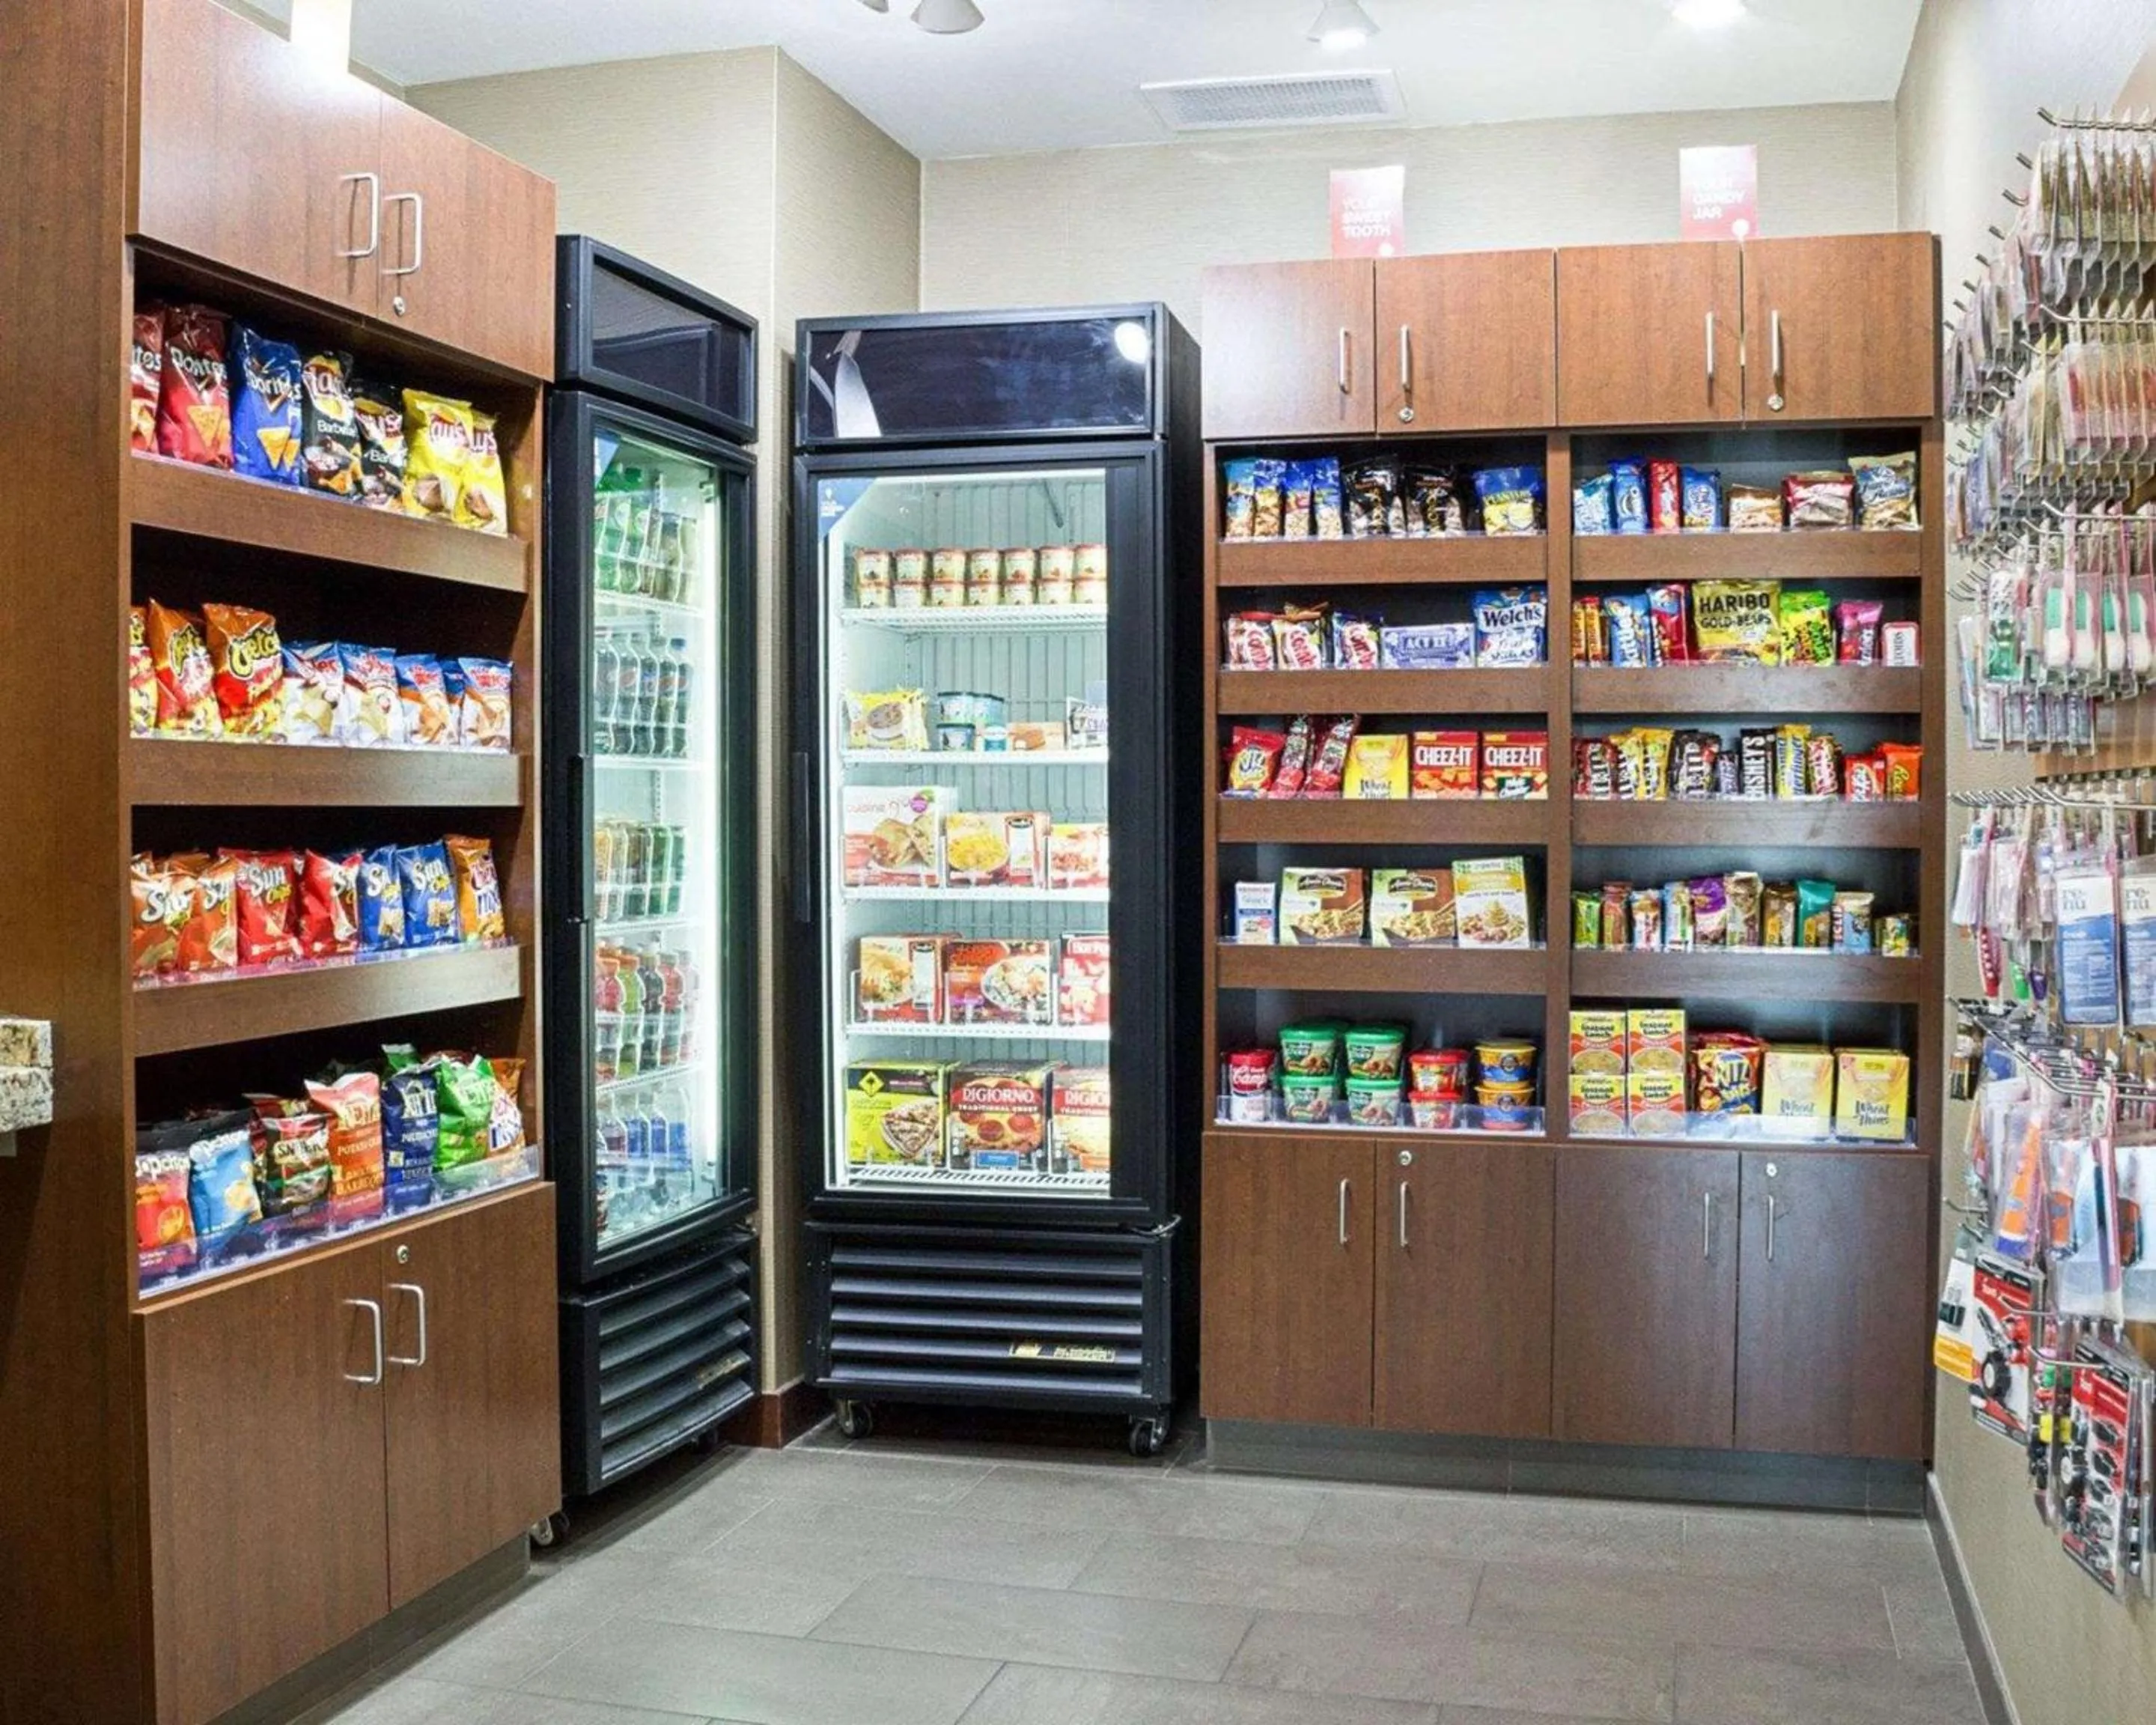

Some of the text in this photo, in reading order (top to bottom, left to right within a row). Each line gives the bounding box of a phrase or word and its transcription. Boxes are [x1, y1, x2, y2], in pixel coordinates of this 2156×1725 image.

[1342, 225, 1392, 238] TOOTH
[1699, 593, 1770, 613] HARIBO
[1483, 606, 1543, 627] Welch's
[1416, 746, 1473, 766] CHEEZ-IT
[1485, 746, 1544, 767] CHEEZ-IT
[1742, 736, 1766, 800] ERSHEY'S
[249, 865, 285, 897] Sun
[962, 1088, 1035, 1104] DIGIORNO
[1064, 1090, 1110, 1106] DIGIO
[1855, 1101, 1890, 1114] Wheat
